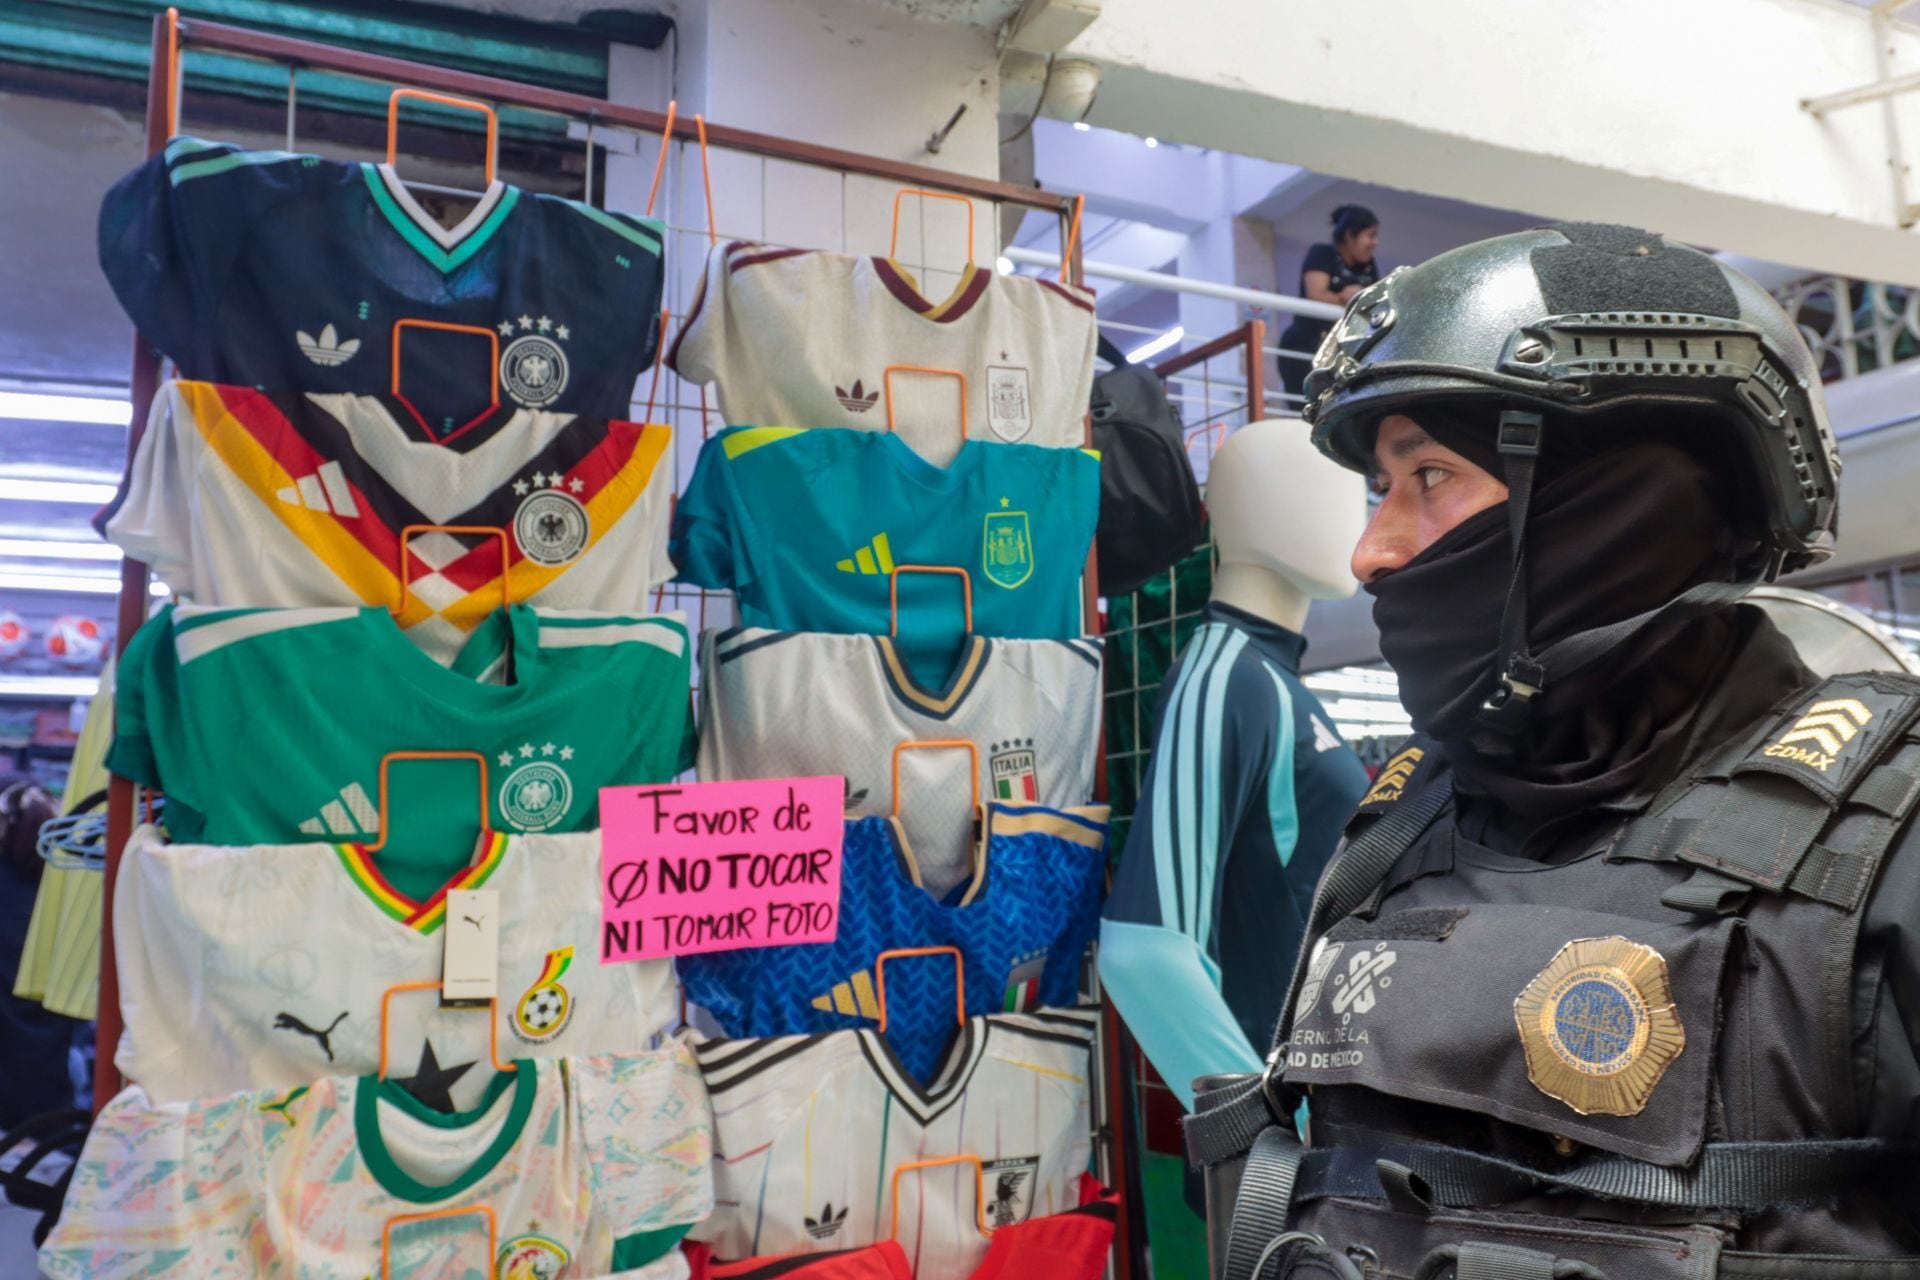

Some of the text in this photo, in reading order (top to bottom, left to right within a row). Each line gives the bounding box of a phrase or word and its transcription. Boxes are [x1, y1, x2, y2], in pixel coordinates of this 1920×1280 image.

[994, 756, 1031, 773] ITALIA
[1763, 744, 1836, 771] CDMX
[773, 786, 812, 832] de
[658, 849, 833, 894] NO TOCAR
[604, 902, 833, 959] NI TOMAR FOTO
[1551, 971, 1601, 1002] SEGURIDAD
[1348, 1027, 1369, 1044] LA
[1311, 1052, 1330, 1069] DE
[1579, 1063, 1593, 1074] DE
